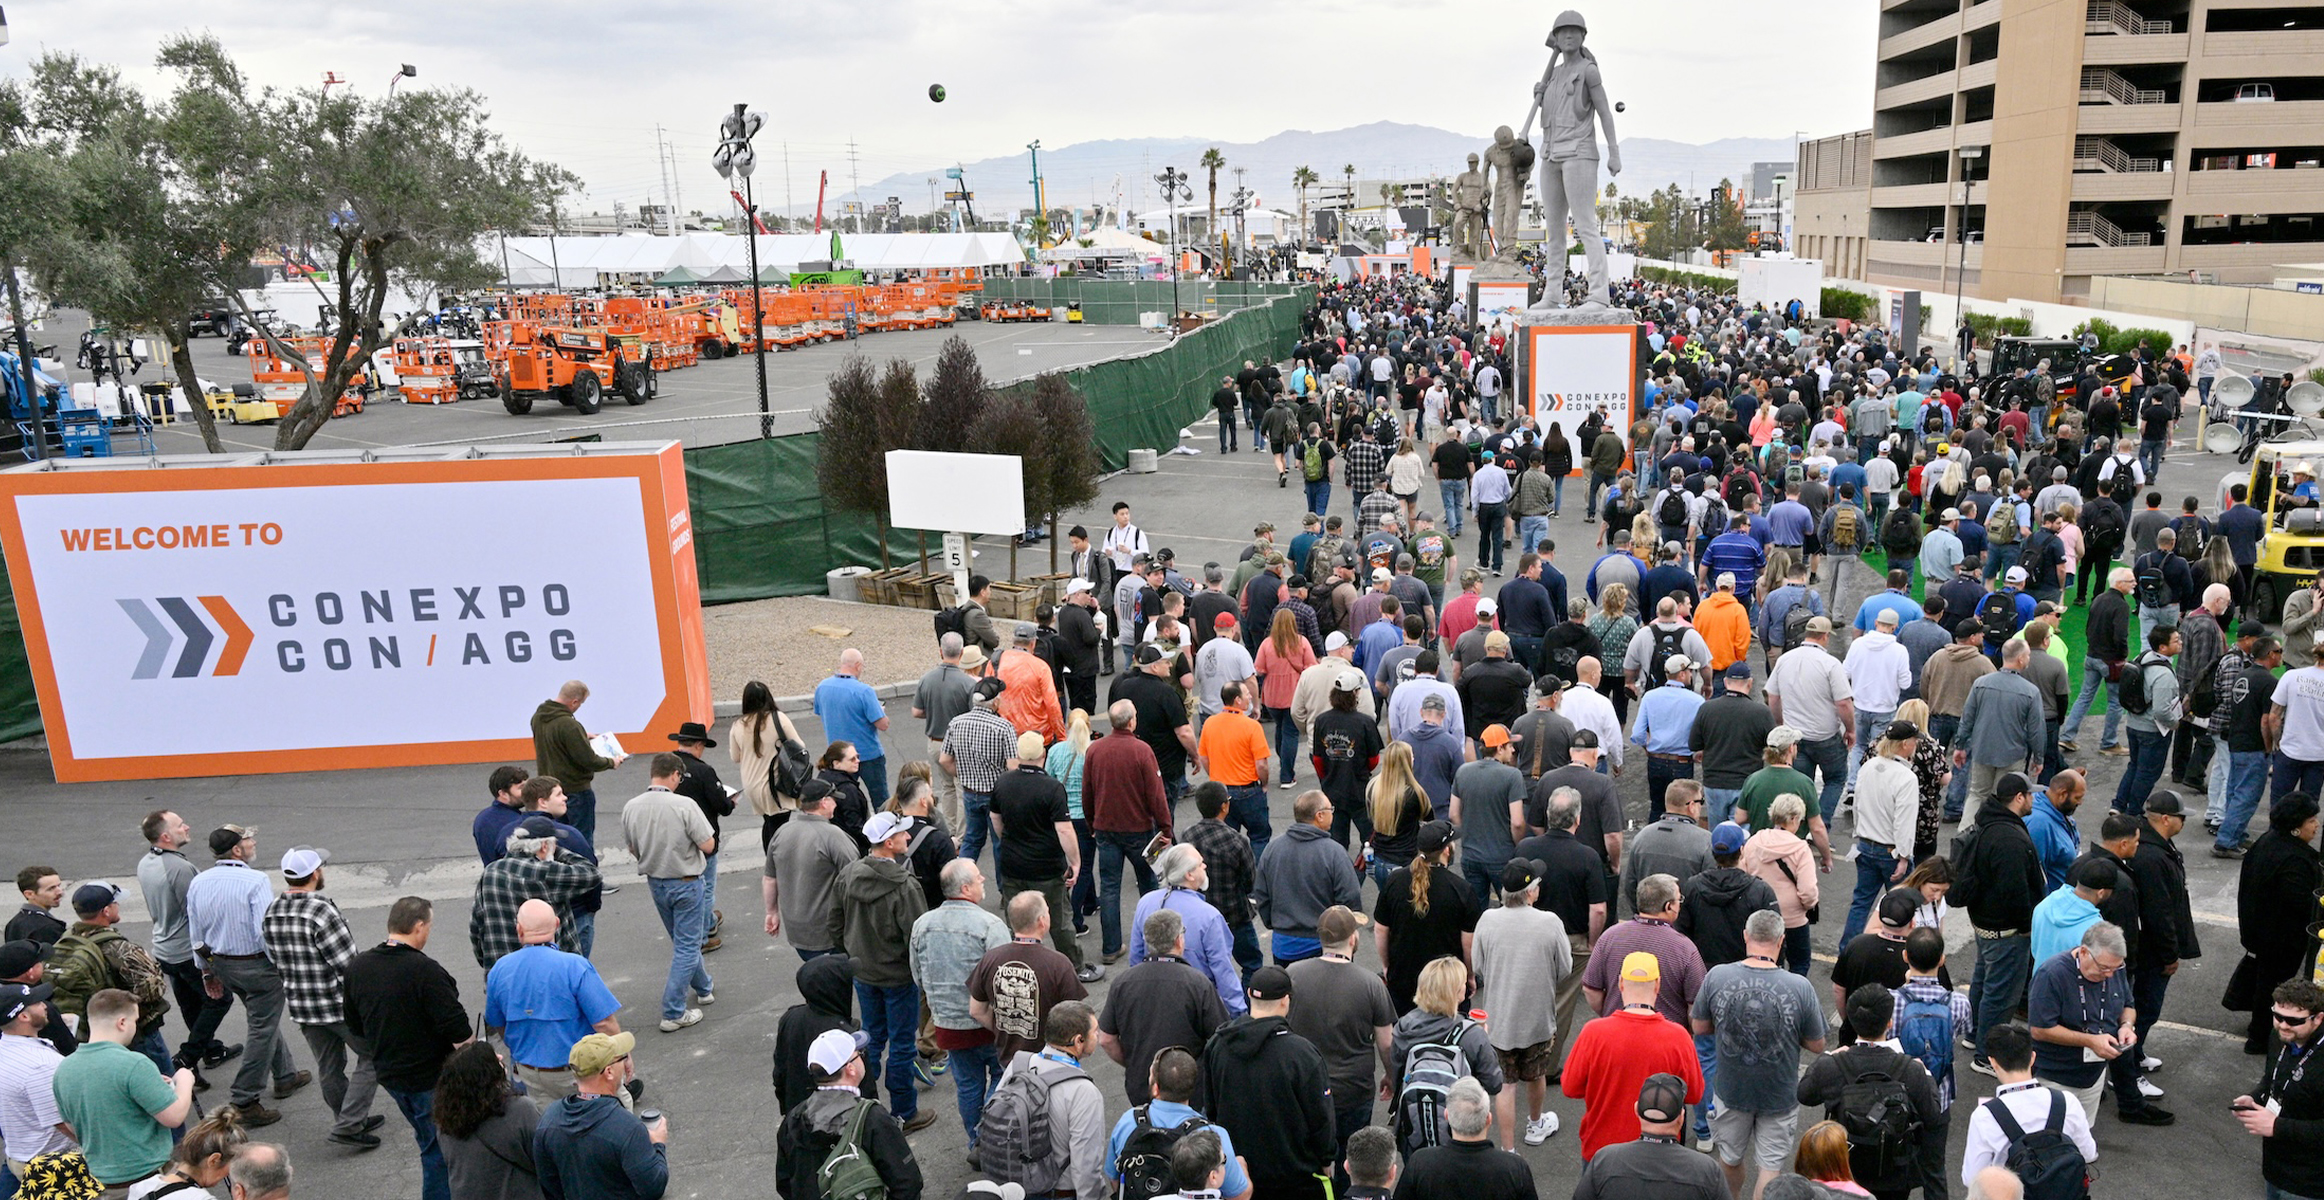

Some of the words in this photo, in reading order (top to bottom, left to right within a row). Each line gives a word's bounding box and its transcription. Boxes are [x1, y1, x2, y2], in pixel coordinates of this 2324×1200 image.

[1566, 393, 1627, 401] CONEXPO
[60, 524, 230, 551] WELCOME
[238, 522, 283, 546] TO
[672, 528, 690, 556] GROUNDS
[951, 552, 961, 567] 5
[268, 583, 570, 627] CONEXPO
[997, 965, 1036, 982] YOSEMITE
[1738, 977, 1766, 990] AIR
[1770, 983, 1795, 1028] LAND
